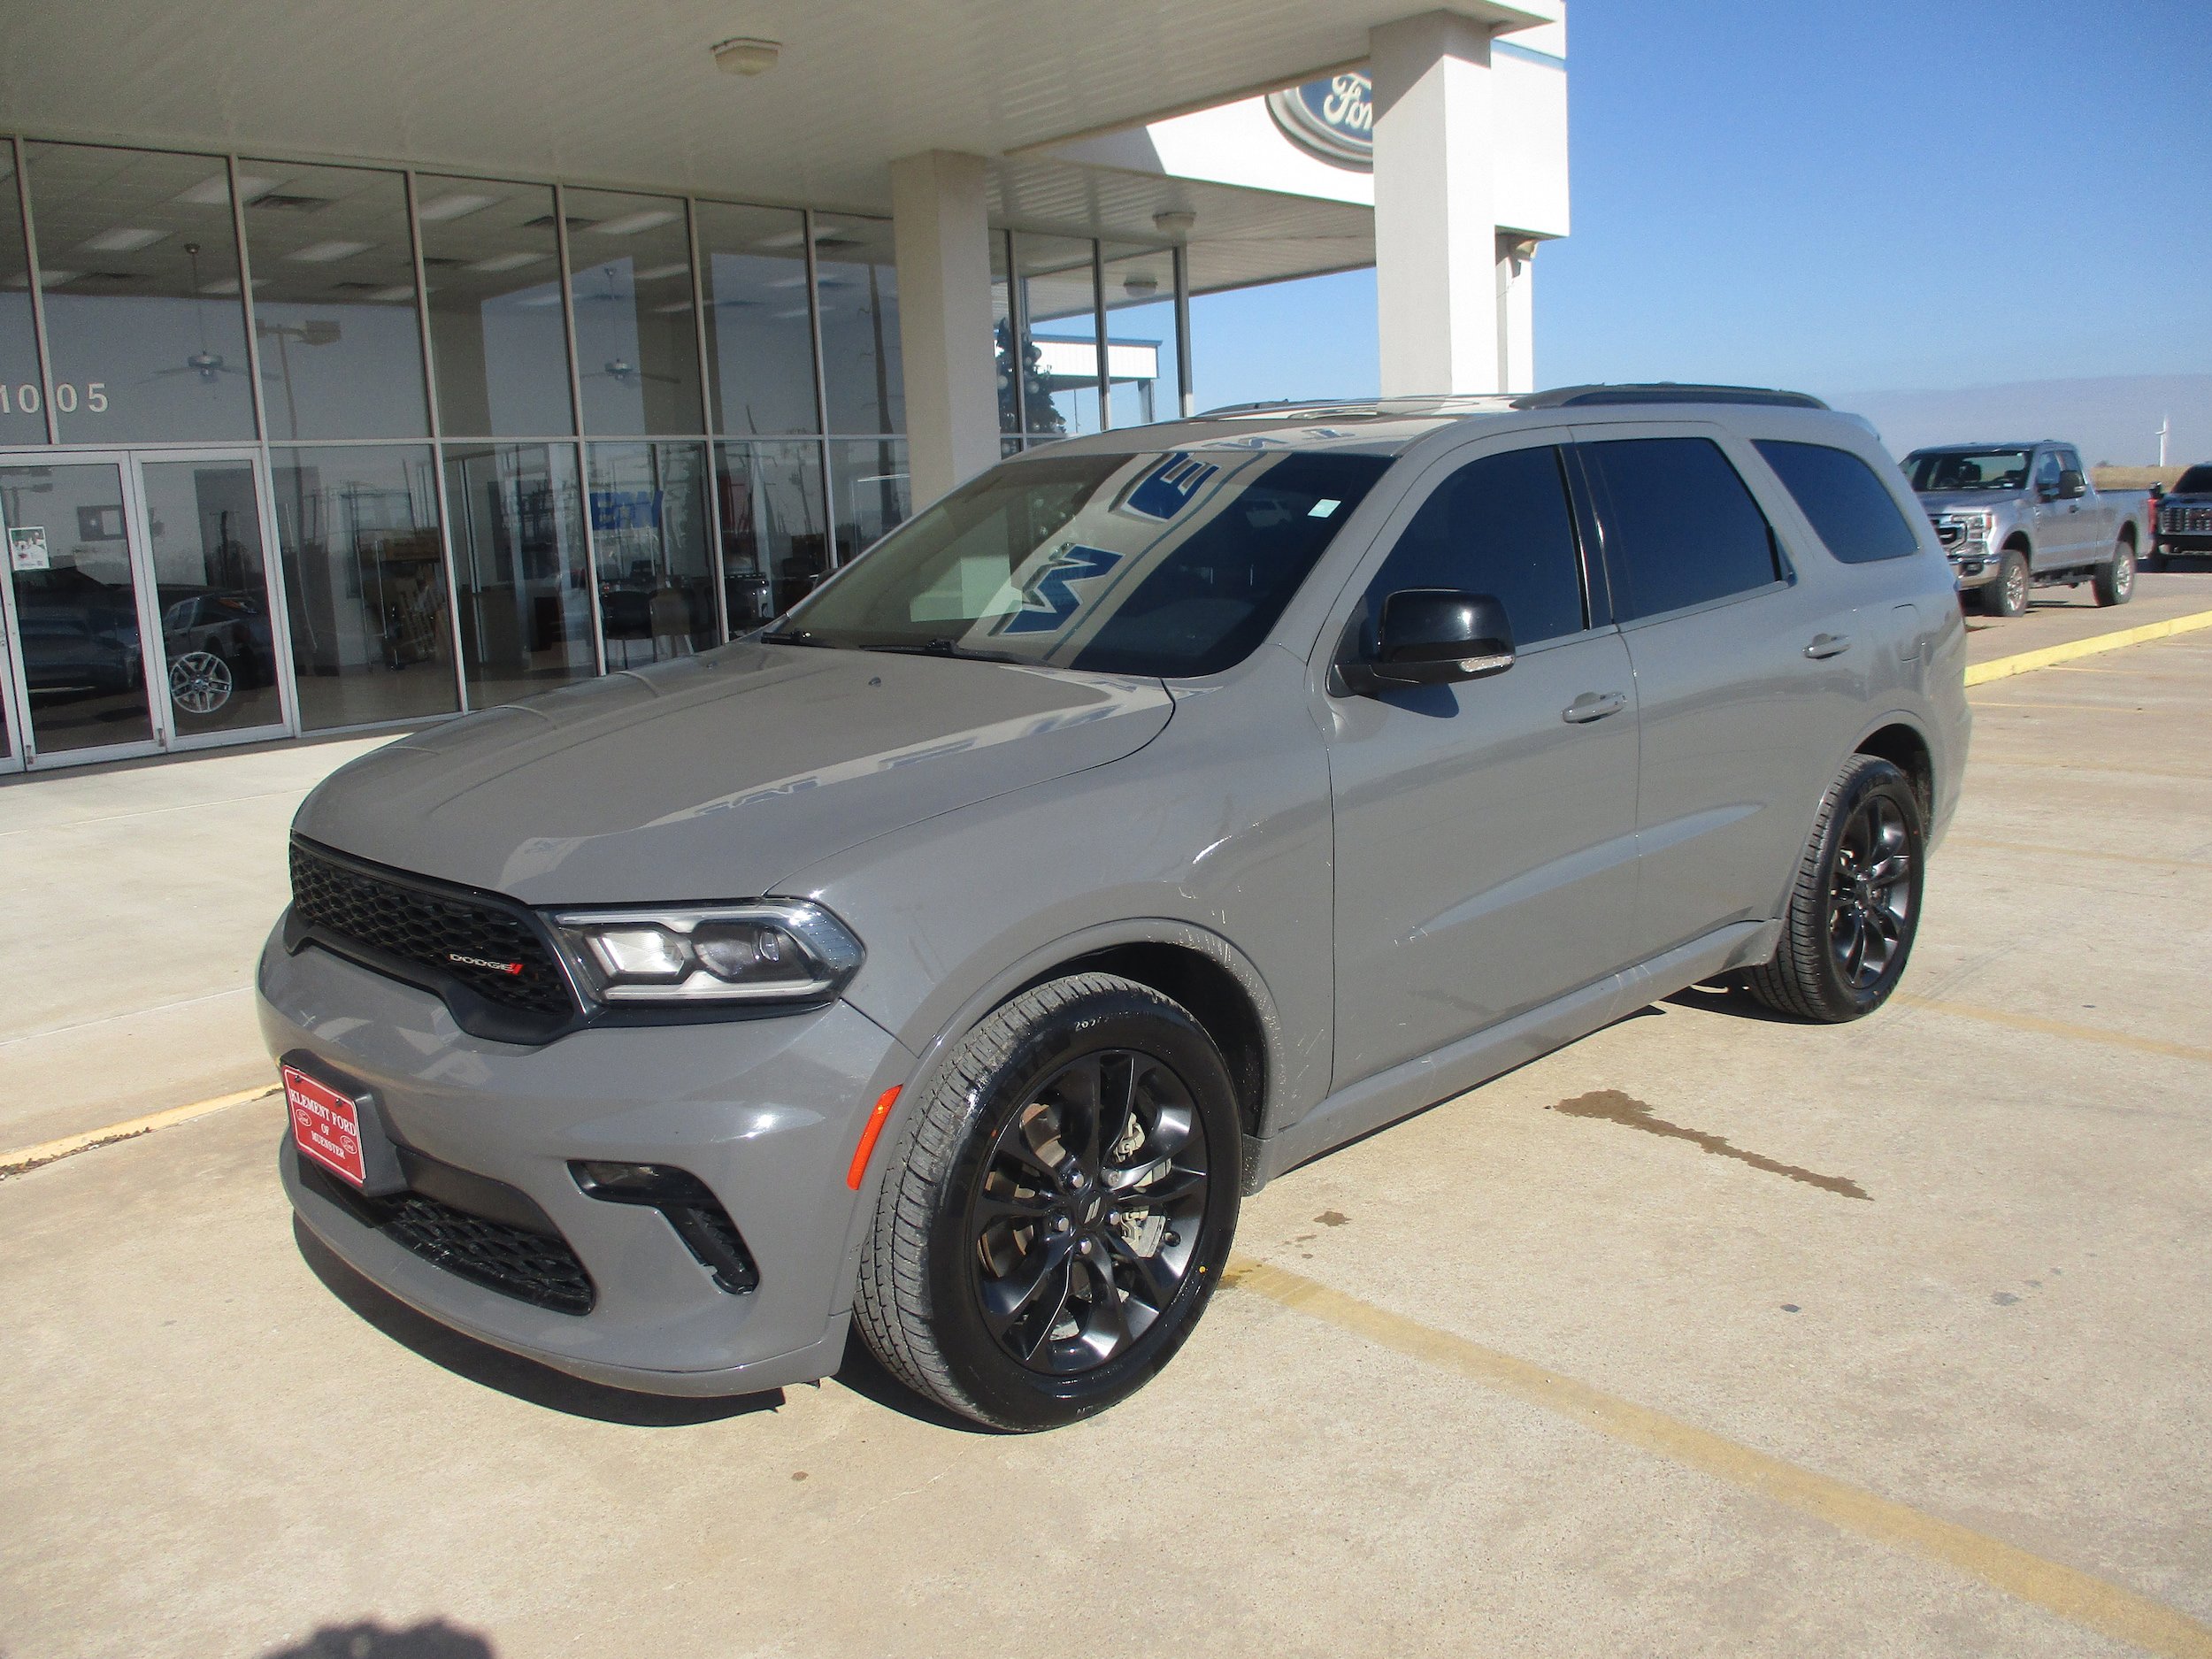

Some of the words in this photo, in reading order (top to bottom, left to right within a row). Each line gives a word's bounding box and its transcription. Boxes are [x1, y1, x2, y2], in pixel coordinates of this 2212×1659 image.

[0, 383, 108, 414] 1005
[449, 953, 514, 972] DODGE
[289, 1088, 330, 1121] KLEMENT
[331, 1111, 356, 1136] FORD
[321, 1123, 330, 1136] OF
[311, 1130, 345, 1159] MUENSTER
